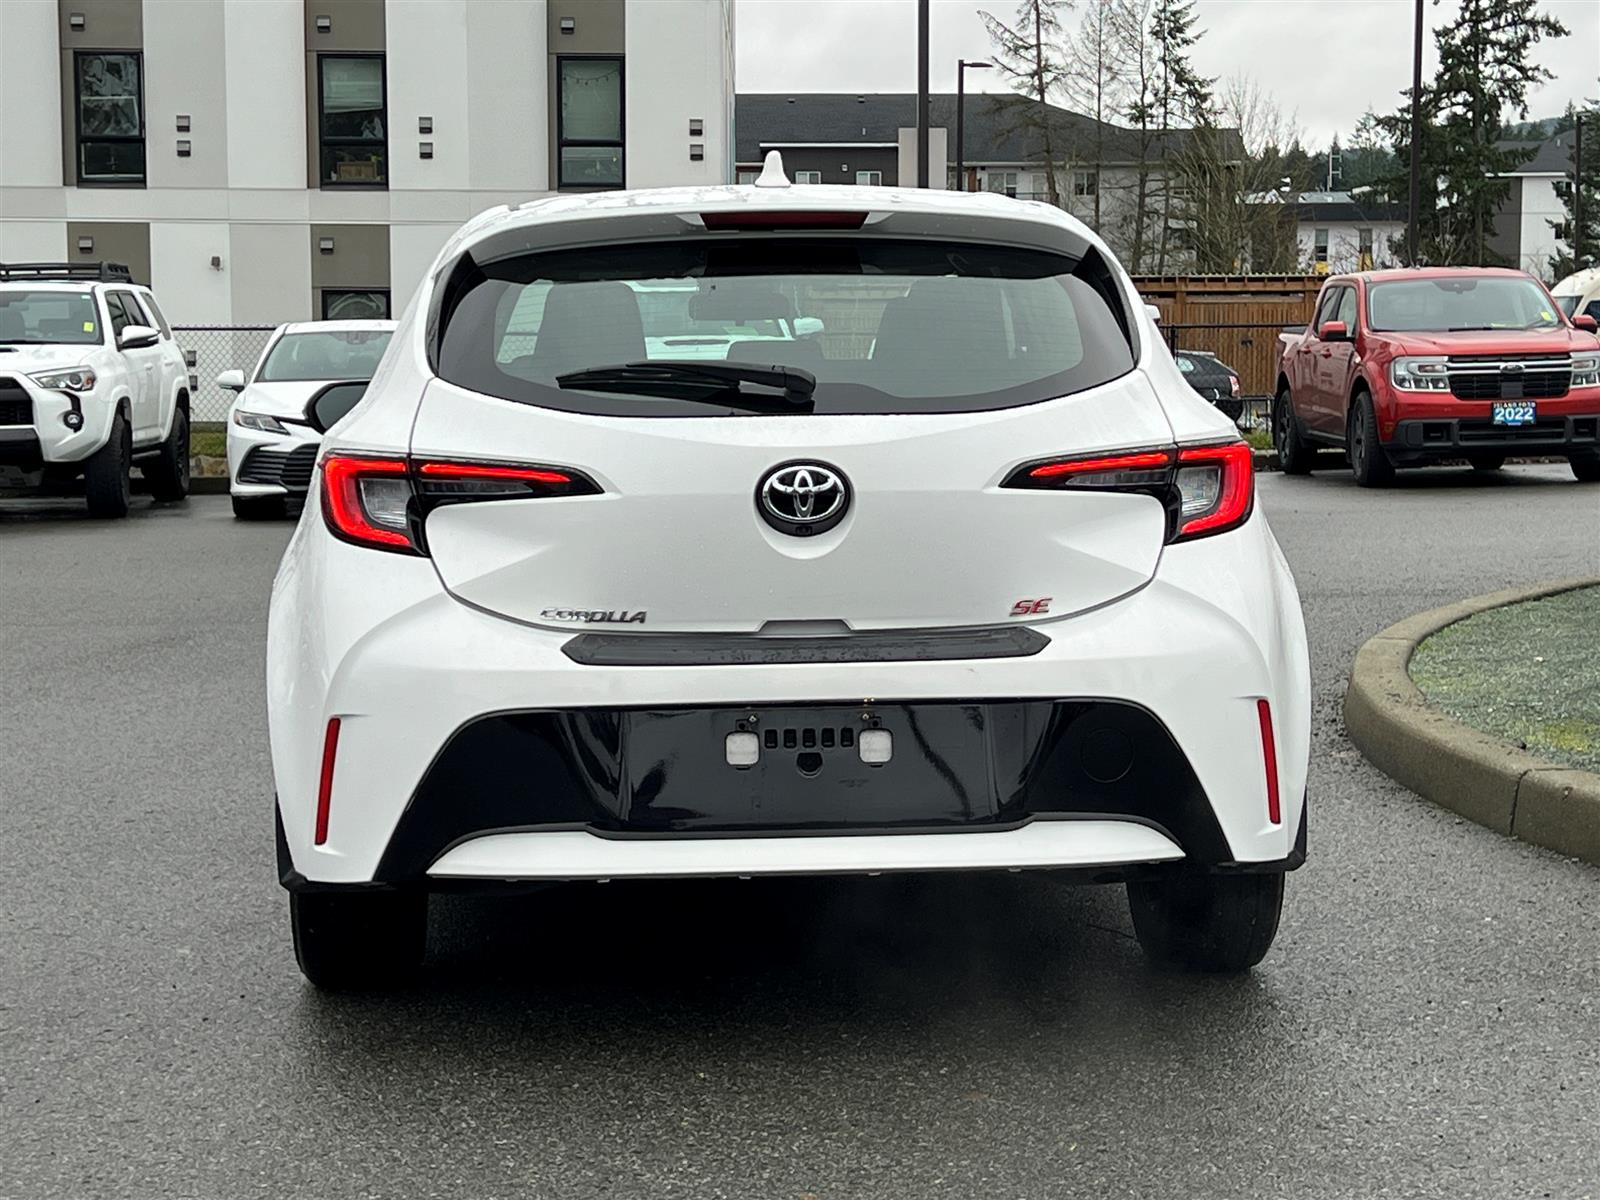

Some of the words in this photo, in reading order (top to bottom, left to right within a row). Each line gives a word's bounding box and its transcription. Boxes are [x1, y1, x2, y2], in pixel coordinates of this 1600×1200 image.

[1495, 407, 1533, 420] 2022
[540, 607, 648, 624] COROLLA
[1009, 597, 1053, 617] SE
